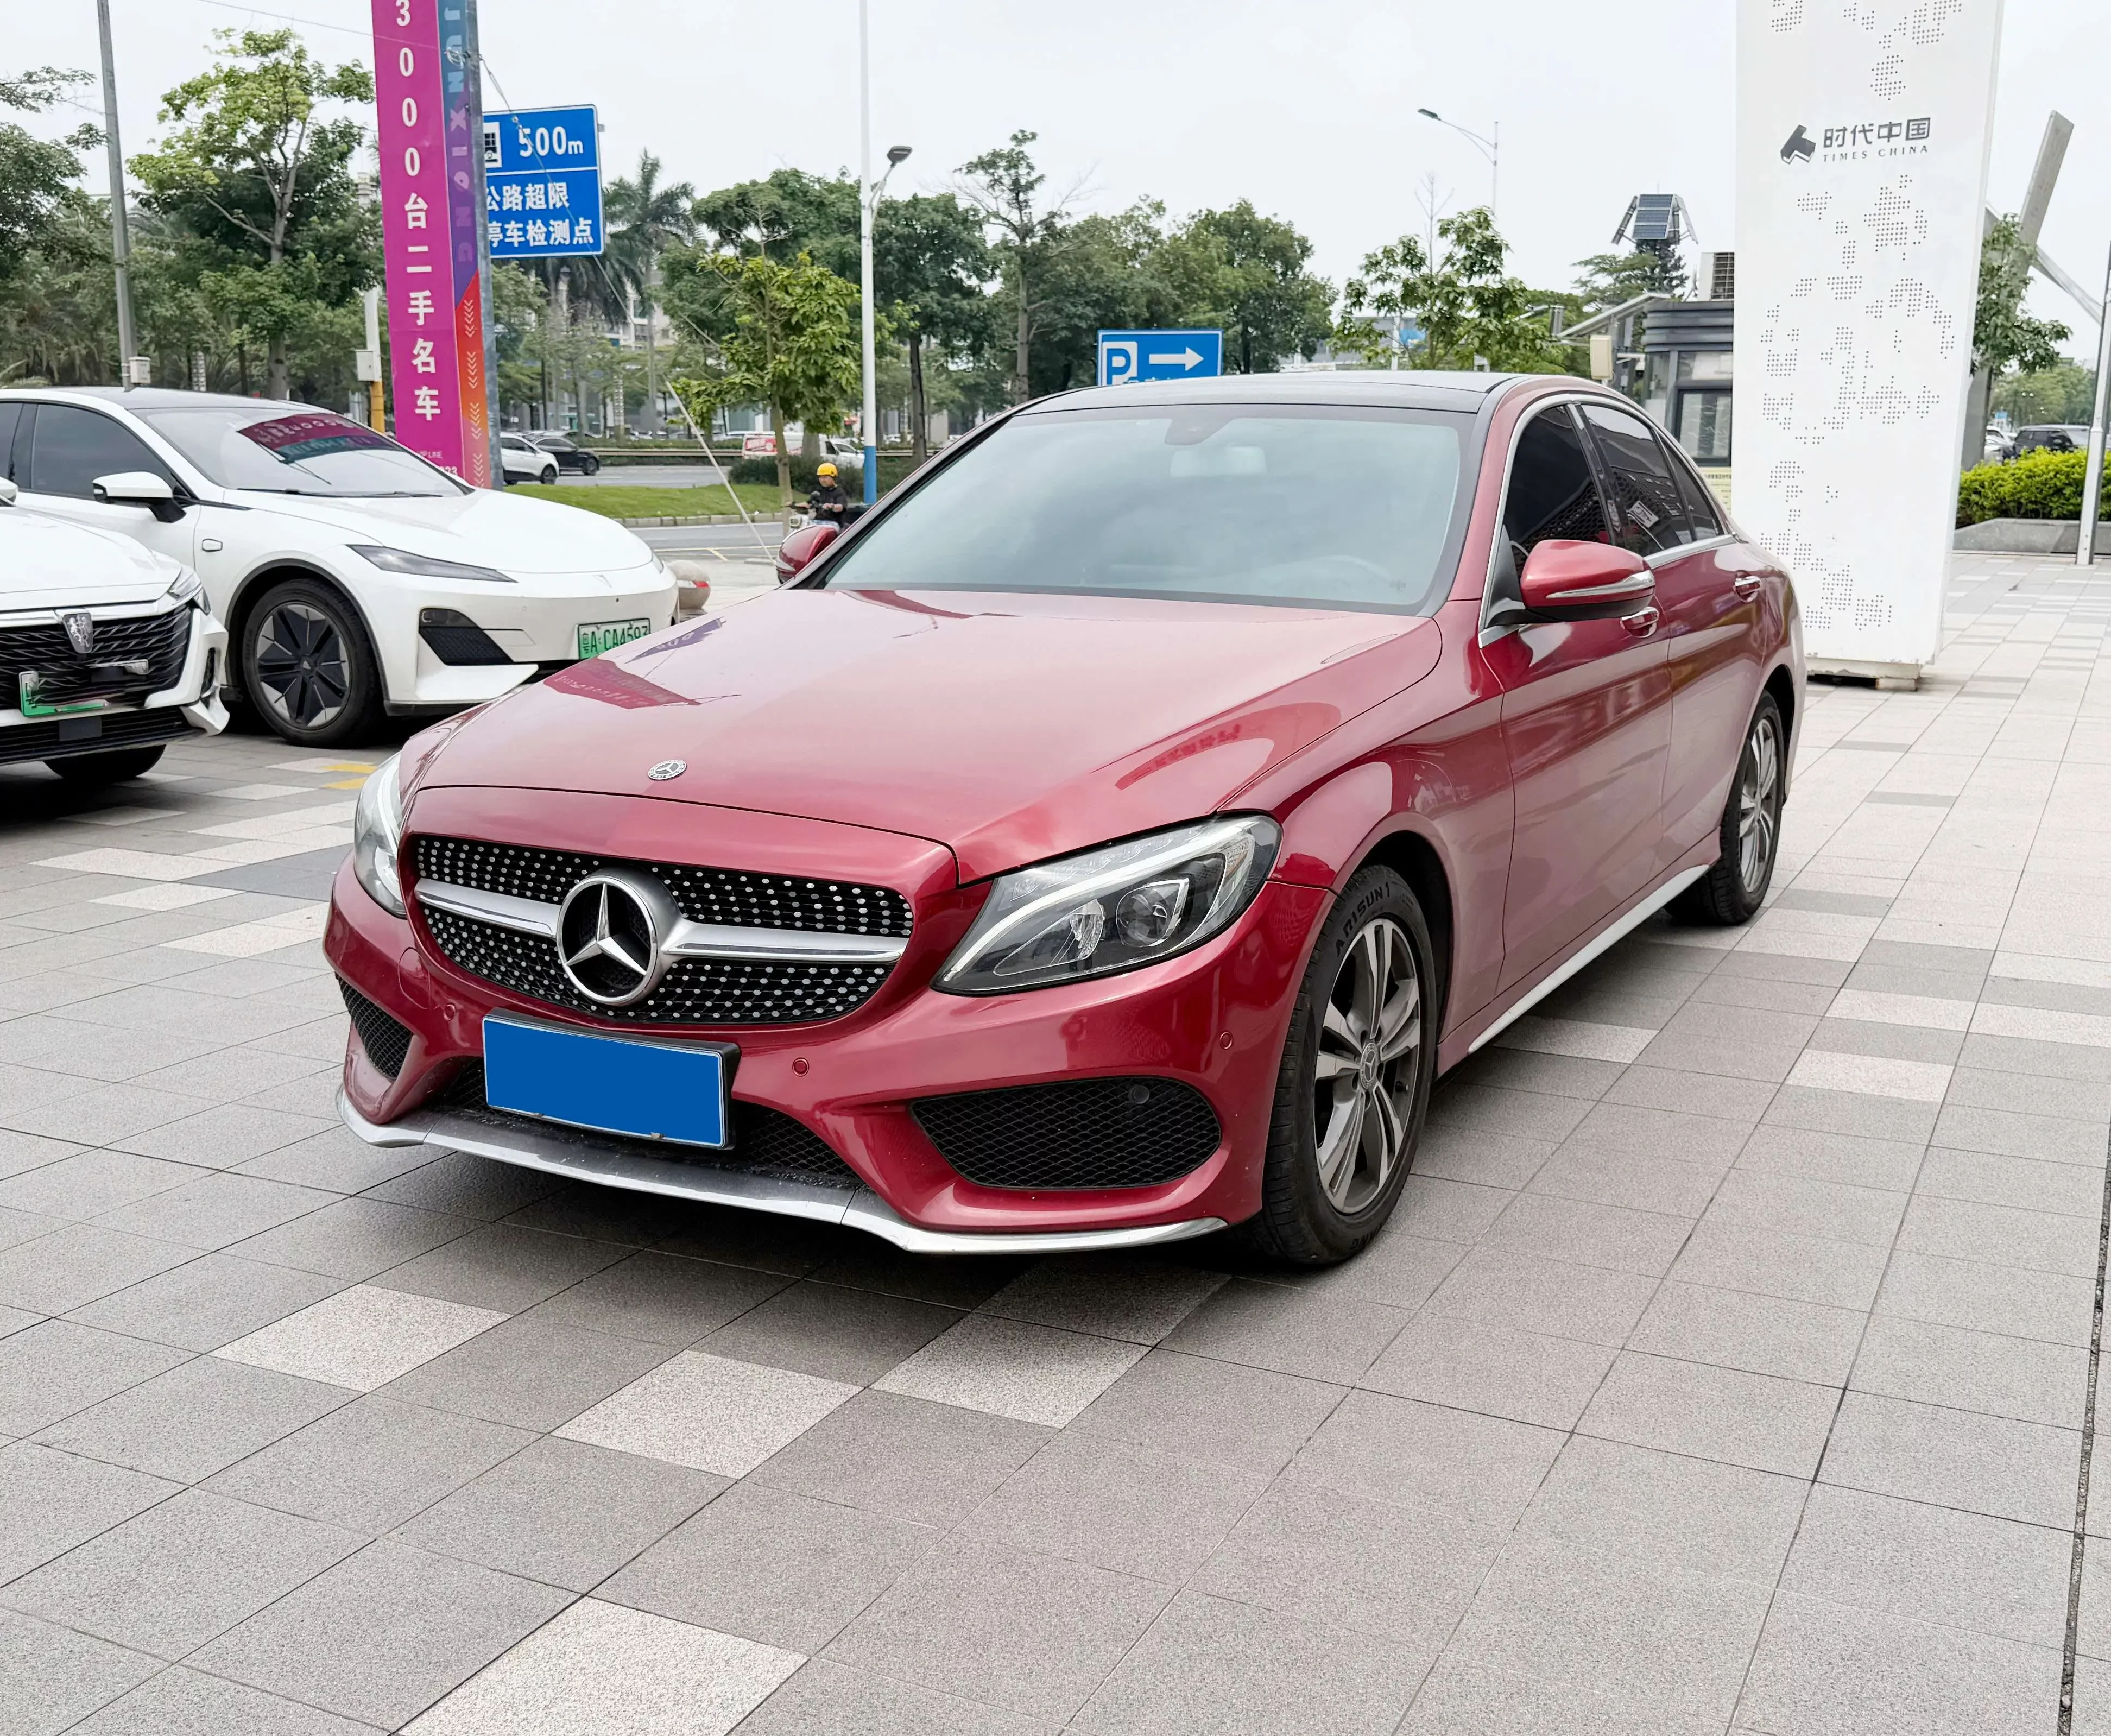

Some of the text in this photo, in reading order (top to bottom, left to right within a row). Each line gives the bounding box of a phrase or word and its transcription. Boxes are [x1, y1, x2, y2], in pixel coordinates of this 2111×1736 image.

[518, 126, 584, 157] 500m
[1823, 117, 1931, 148] 时代中国
[1823, 145, 1927, 162] TIMES CHINA
